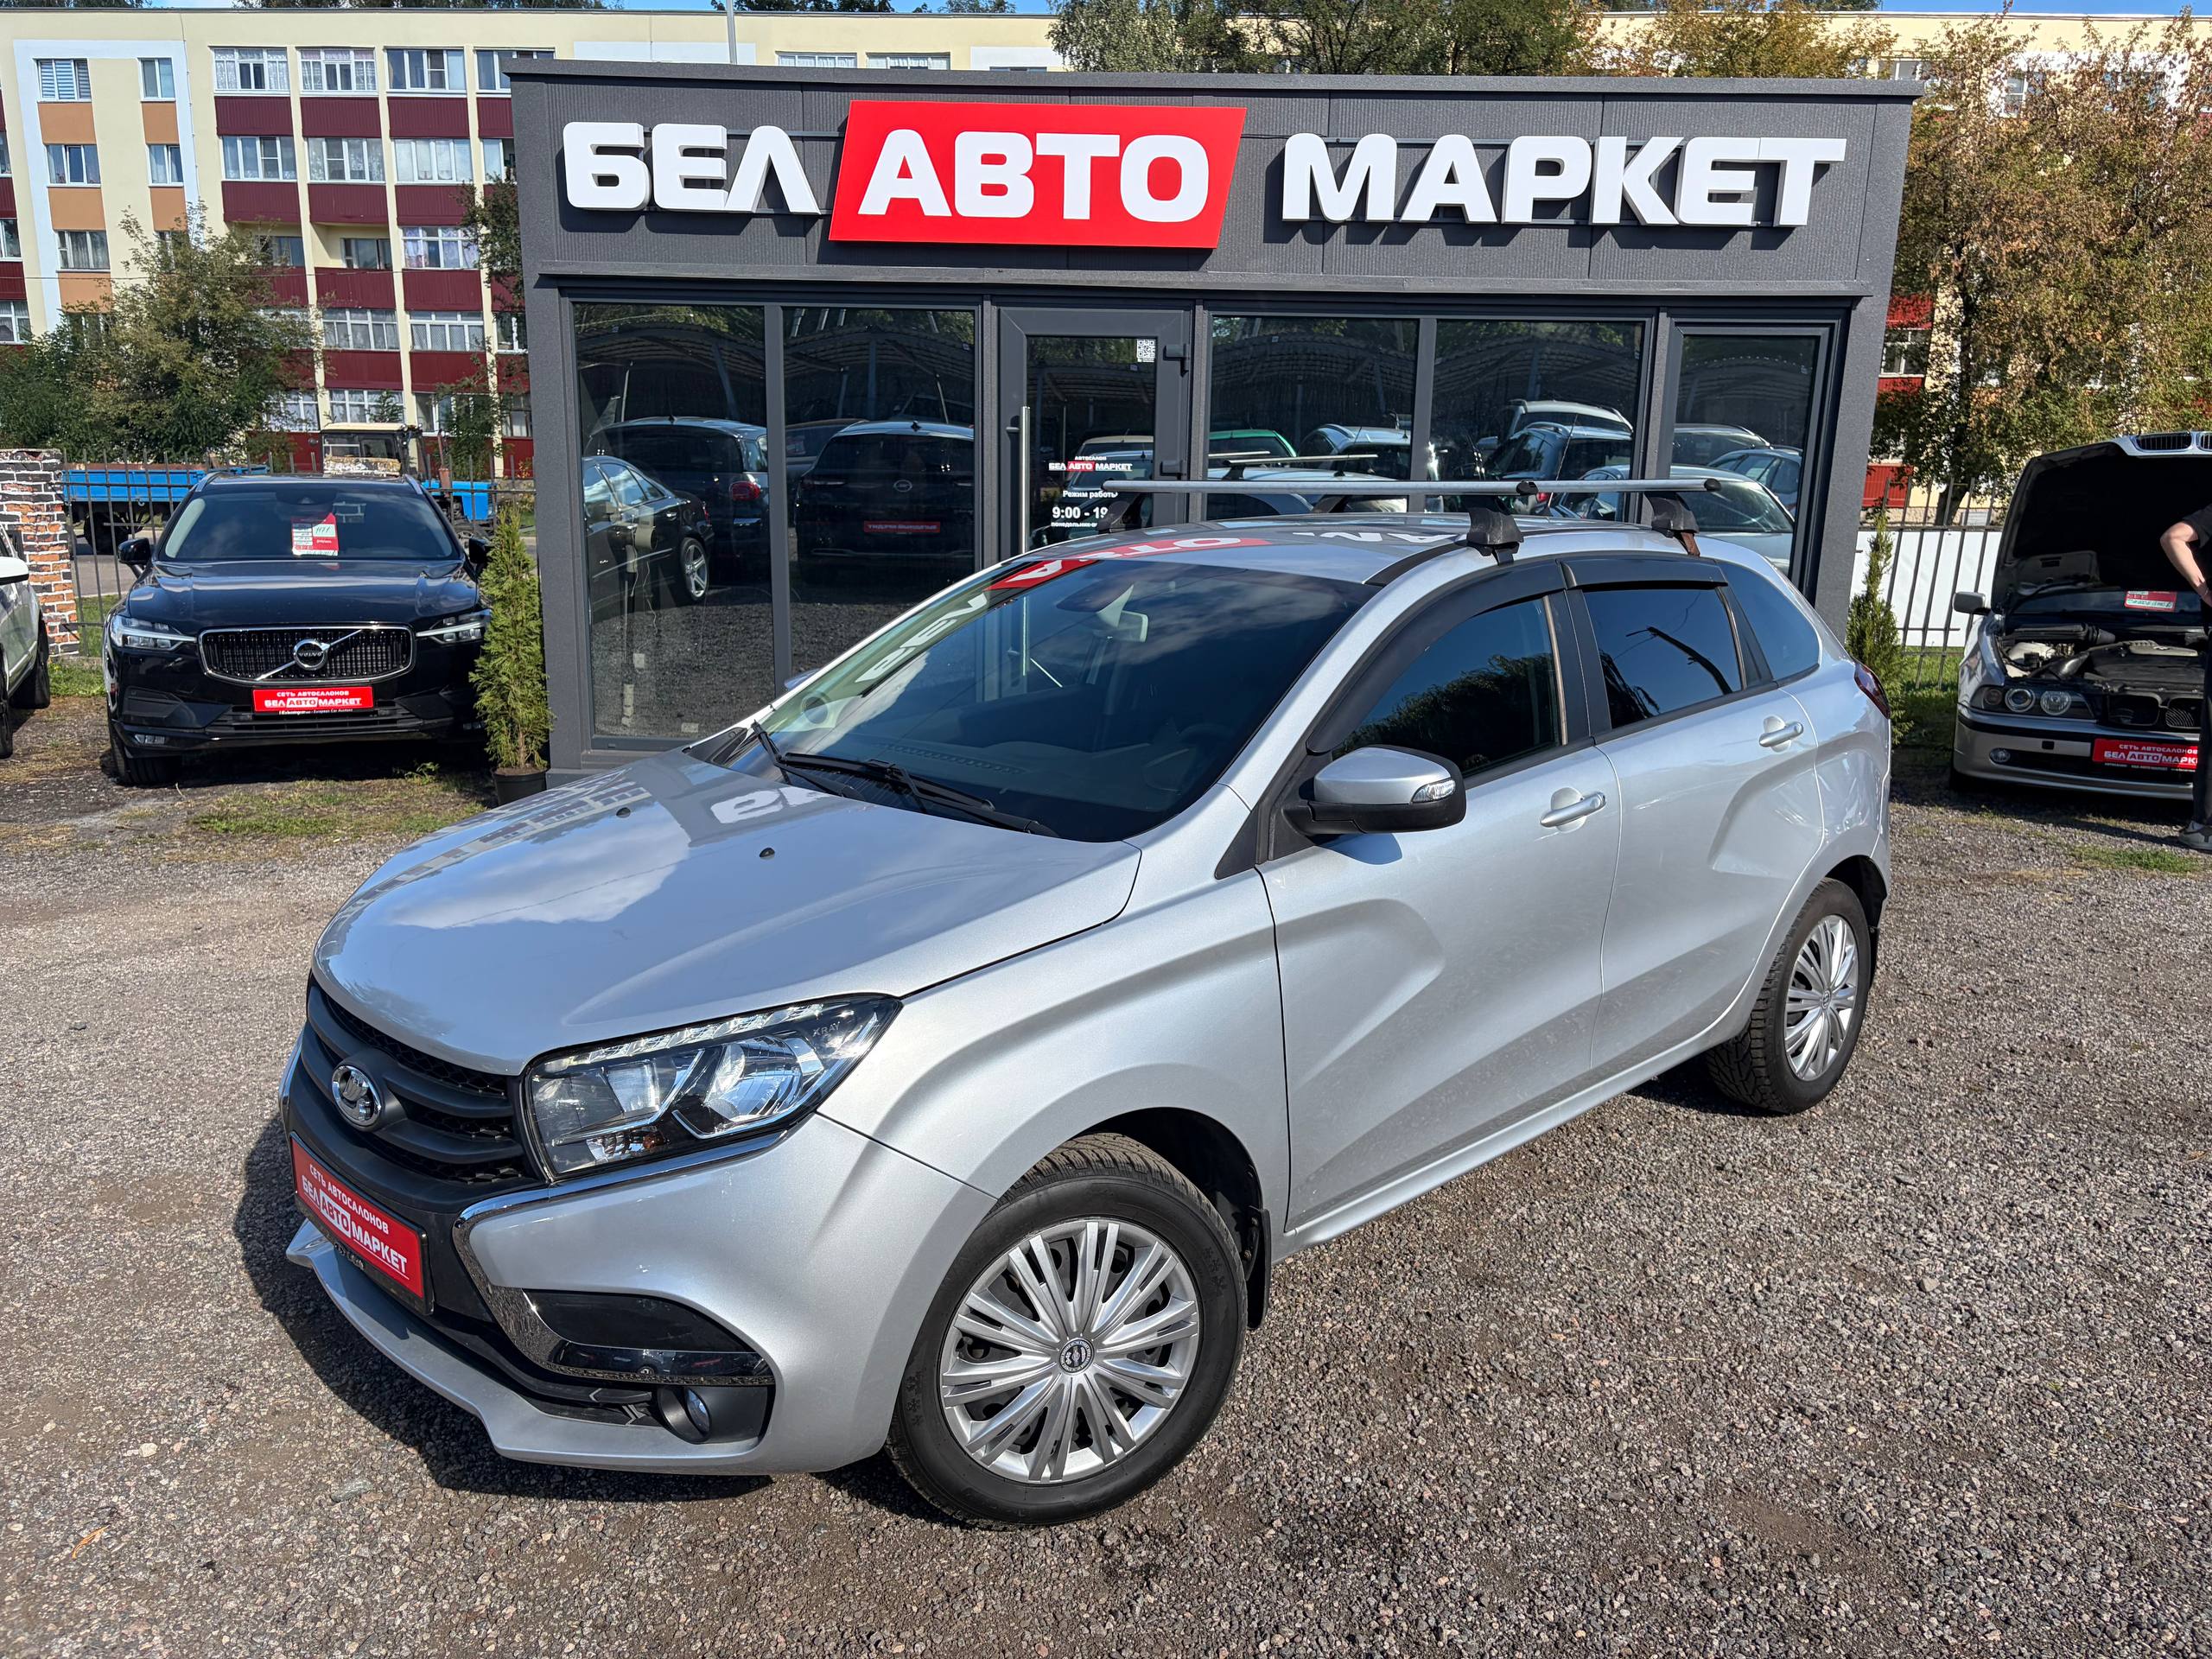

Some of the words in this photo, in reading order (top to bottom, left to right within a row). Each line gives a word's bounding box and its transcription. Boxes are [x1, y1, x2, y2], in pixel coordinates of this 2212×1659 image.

[563, 121, 821, 215] БЕЛ
[858, 128, 1210, 223] АВТО
[1281, 132, 1847, 227] МАРКЕТ
[1048, 462, 1067, 471] БЕЛ
[1068, 462, 1094, 471] АВТО
[1095, 462, 1133, 471] МАРКЕТ
[1052, 506, 1081, 518] 9:00
[264, 699, 286, 708] БЕЛ
[287, 698, 317, 708] АВТО
[318, 697, 361, 706] МАРКЕТ
[2104, 750, 2126, 759] БЕЛ
[2127, 752, 2162, 763] АВТО
[2162, 755, 2198, 765] МАРК
[812, 1020, 841, 1037] XRAY
[308, 1163, 327, 1188] СЕТЬ
[327, 1181, 390, 1235] АВТОСАЛОНОВ
[302, 1174, 320, 1206] БЕЛ
[321, 1193, 351, 1237] АВТО
[351, 1220, 409, 1274] МАРКЕТ
